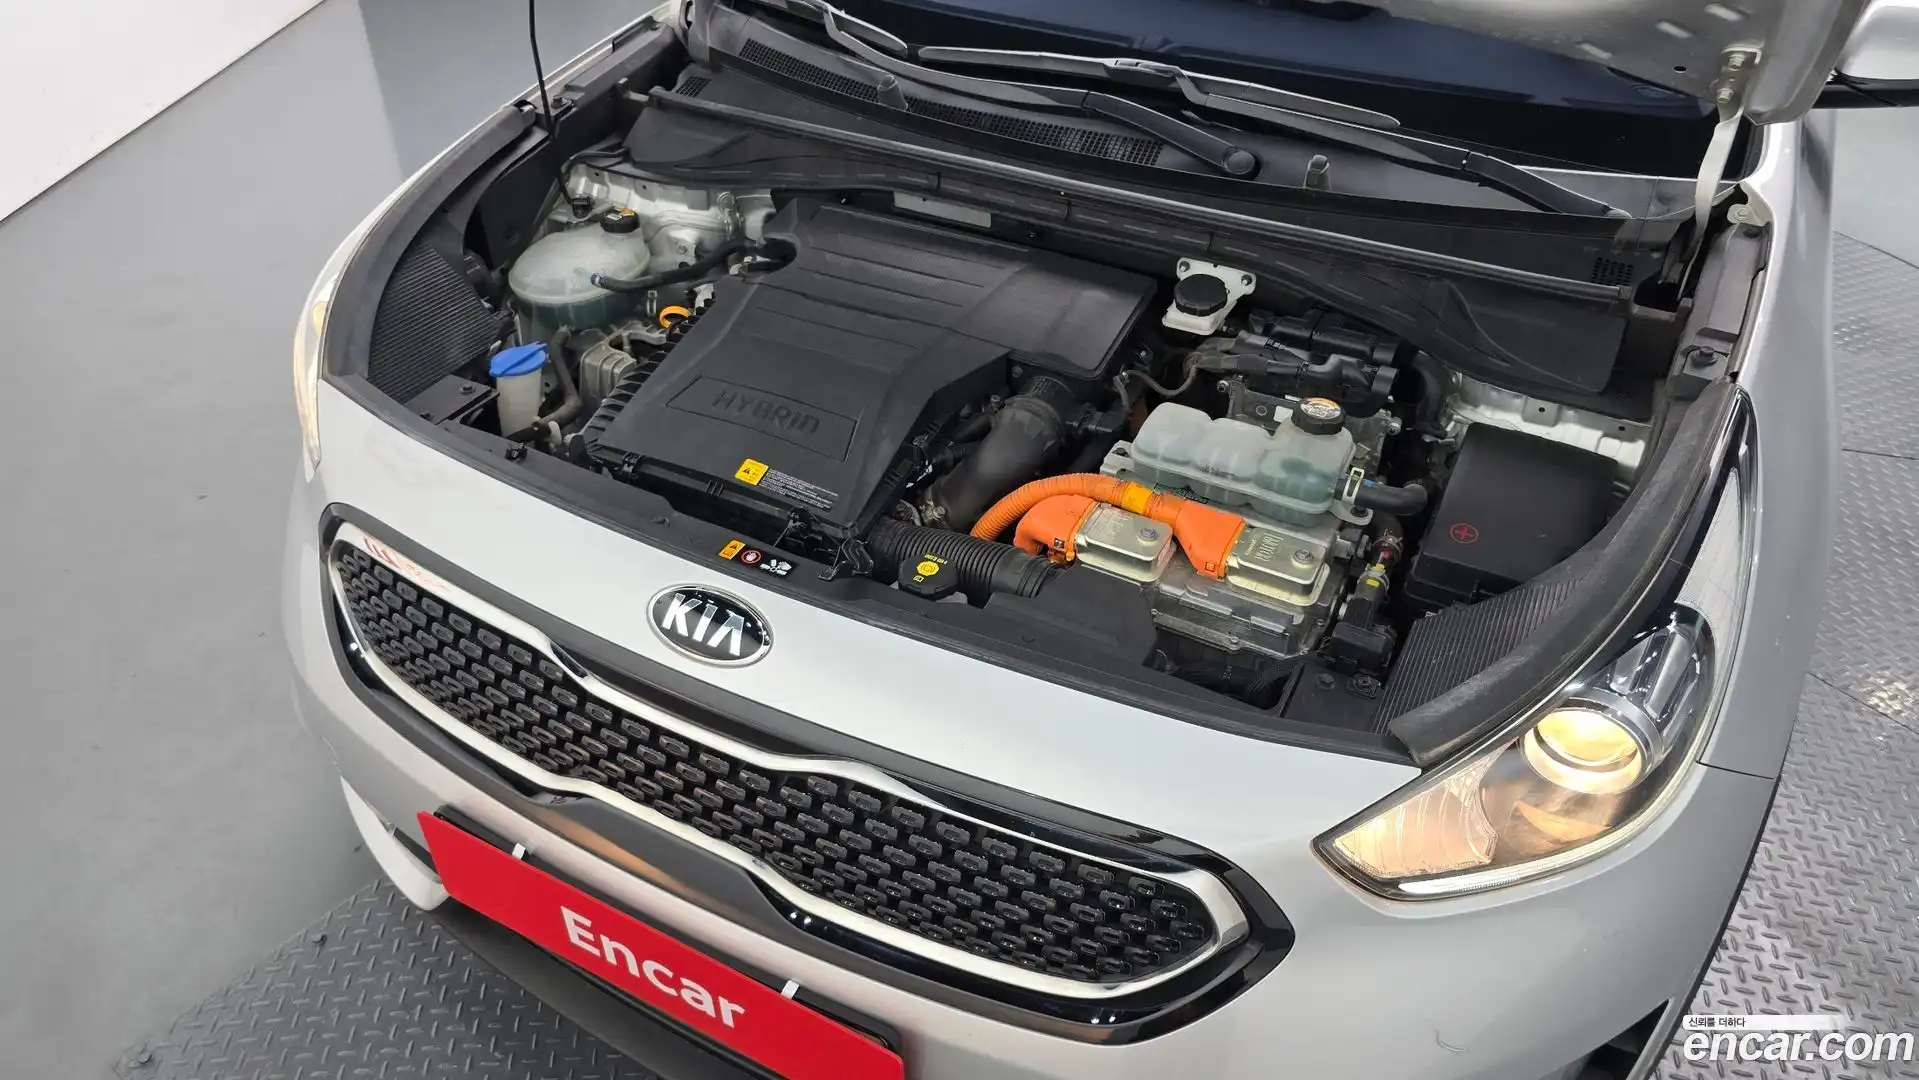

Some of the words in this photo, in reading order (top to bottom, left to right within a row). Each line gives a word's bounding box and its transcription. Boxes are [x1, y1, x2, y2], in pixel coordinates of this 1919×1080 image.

[711, 389, 820, 434] HYBRID
[661, 592, 745, 657] KIA
[560, 905, 746, 1029] Encar
